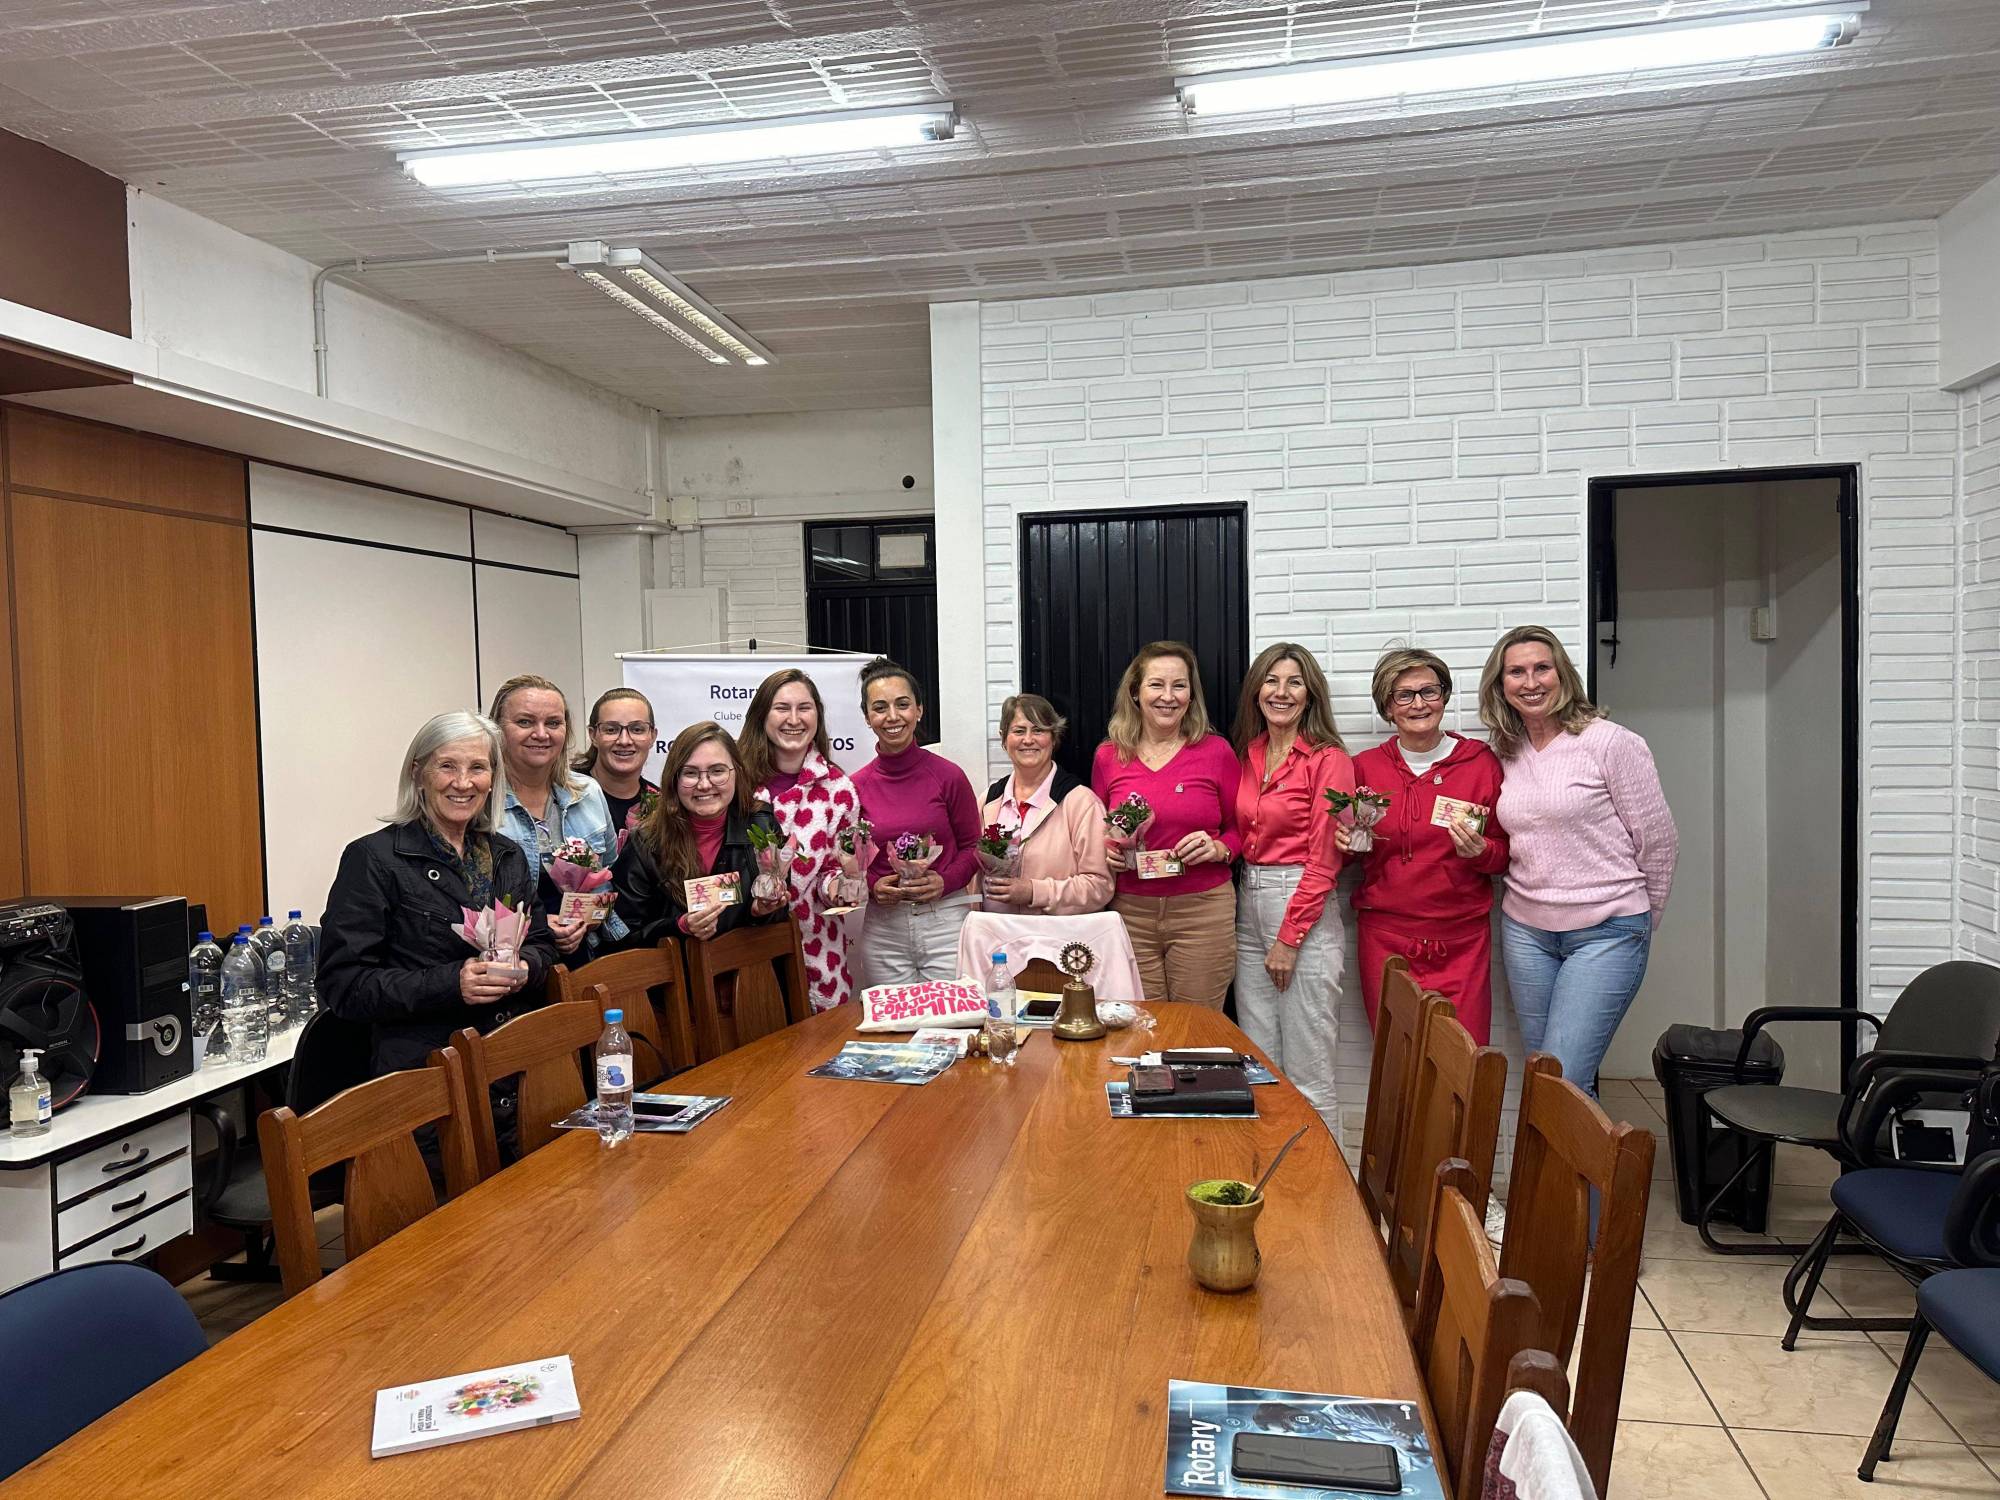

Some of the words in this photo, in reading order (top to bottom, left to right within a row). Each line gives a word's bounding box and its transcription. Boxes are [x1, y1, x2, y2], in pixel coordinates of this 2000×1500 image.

[710, 684, 759, 700] Rotar
[713, 711, 742, 721] Clube
[1183, 1419, 1221, 1486] Rotary
